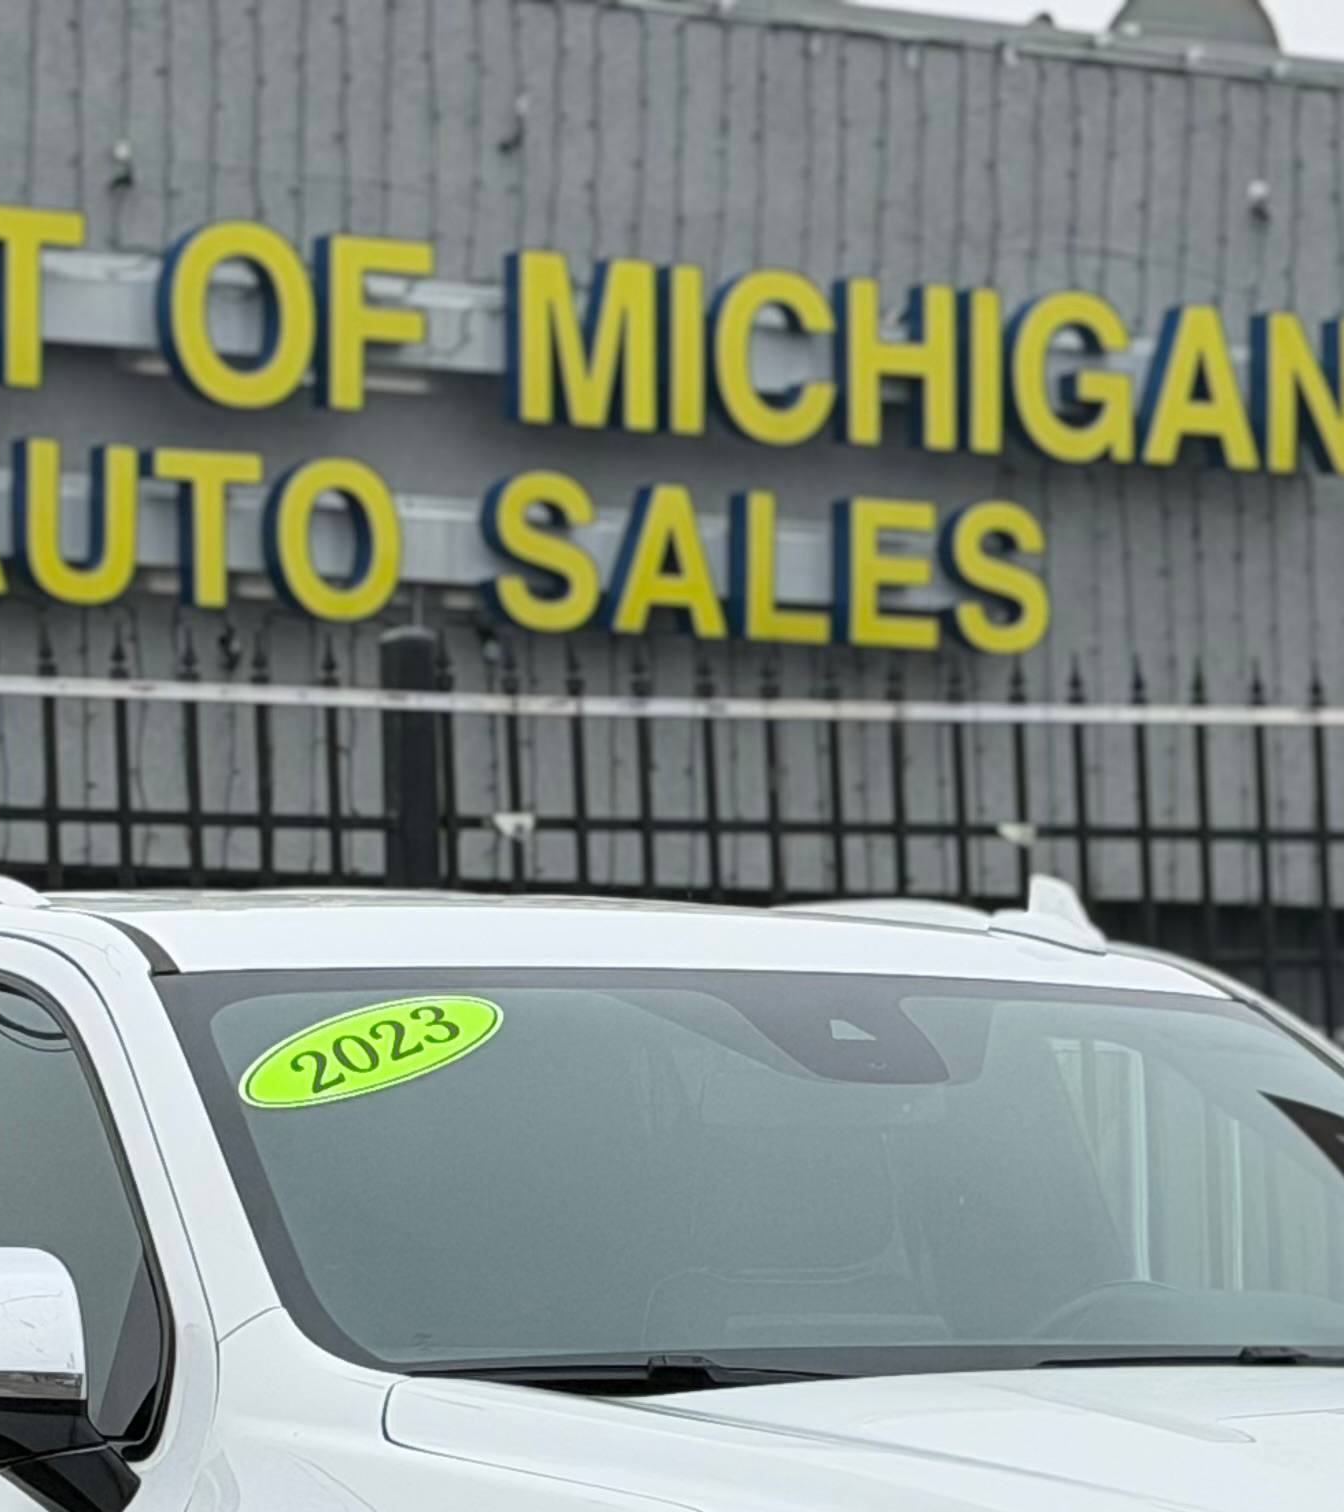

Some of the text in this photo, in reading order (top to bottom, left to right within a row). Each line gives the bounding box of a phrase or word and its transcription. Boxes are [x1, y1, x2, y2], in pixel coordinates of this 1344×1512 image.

[164, 221, 434, 410] OF
[488, 472, 1050, 655] SALES
[290, 1005, 460, 1094] 2023
